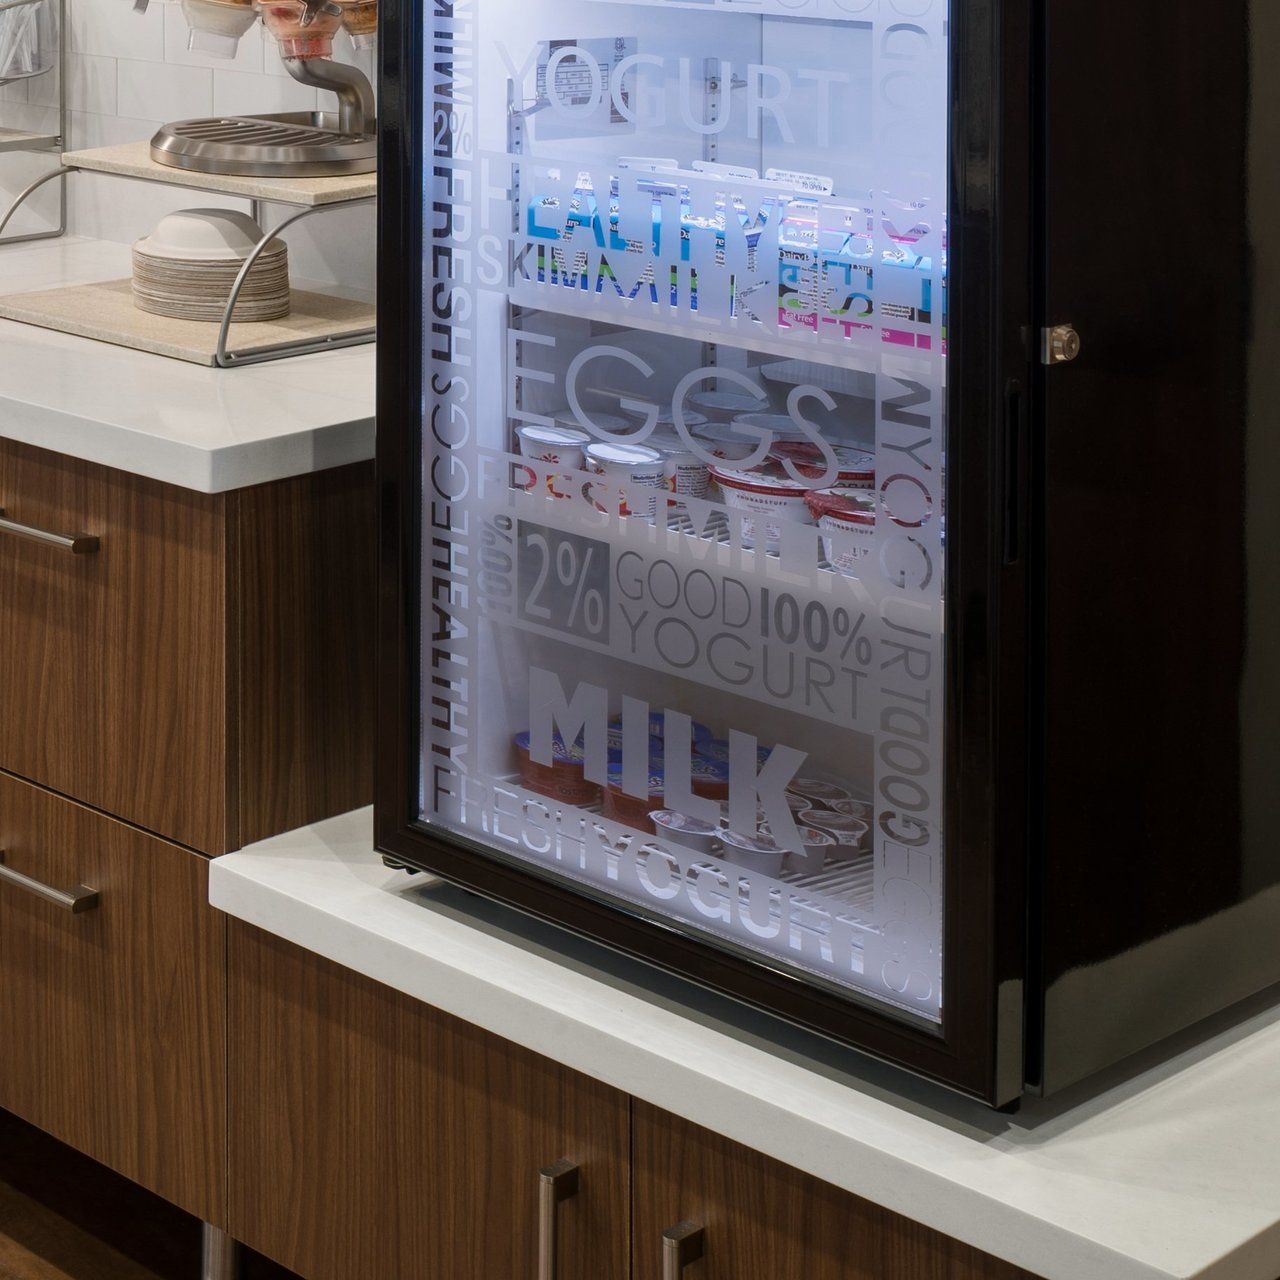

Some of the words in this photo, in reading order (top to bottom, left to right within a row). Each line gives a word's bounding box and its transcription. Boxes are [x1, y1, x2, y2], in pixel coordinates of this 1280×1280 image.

[493, 39, 851, 148] YOGURT
[507, 328, 840, 489] EGGS
[524, 533, 604, 635] 2%
[616, 551, 752, 629] GOOD
[760, 587, 872, 665] 100%
[618, 603, 868, 720] YOGURT
[529, 665, 809, 857] MILK
[878, 704, 931, 847] GOOD
